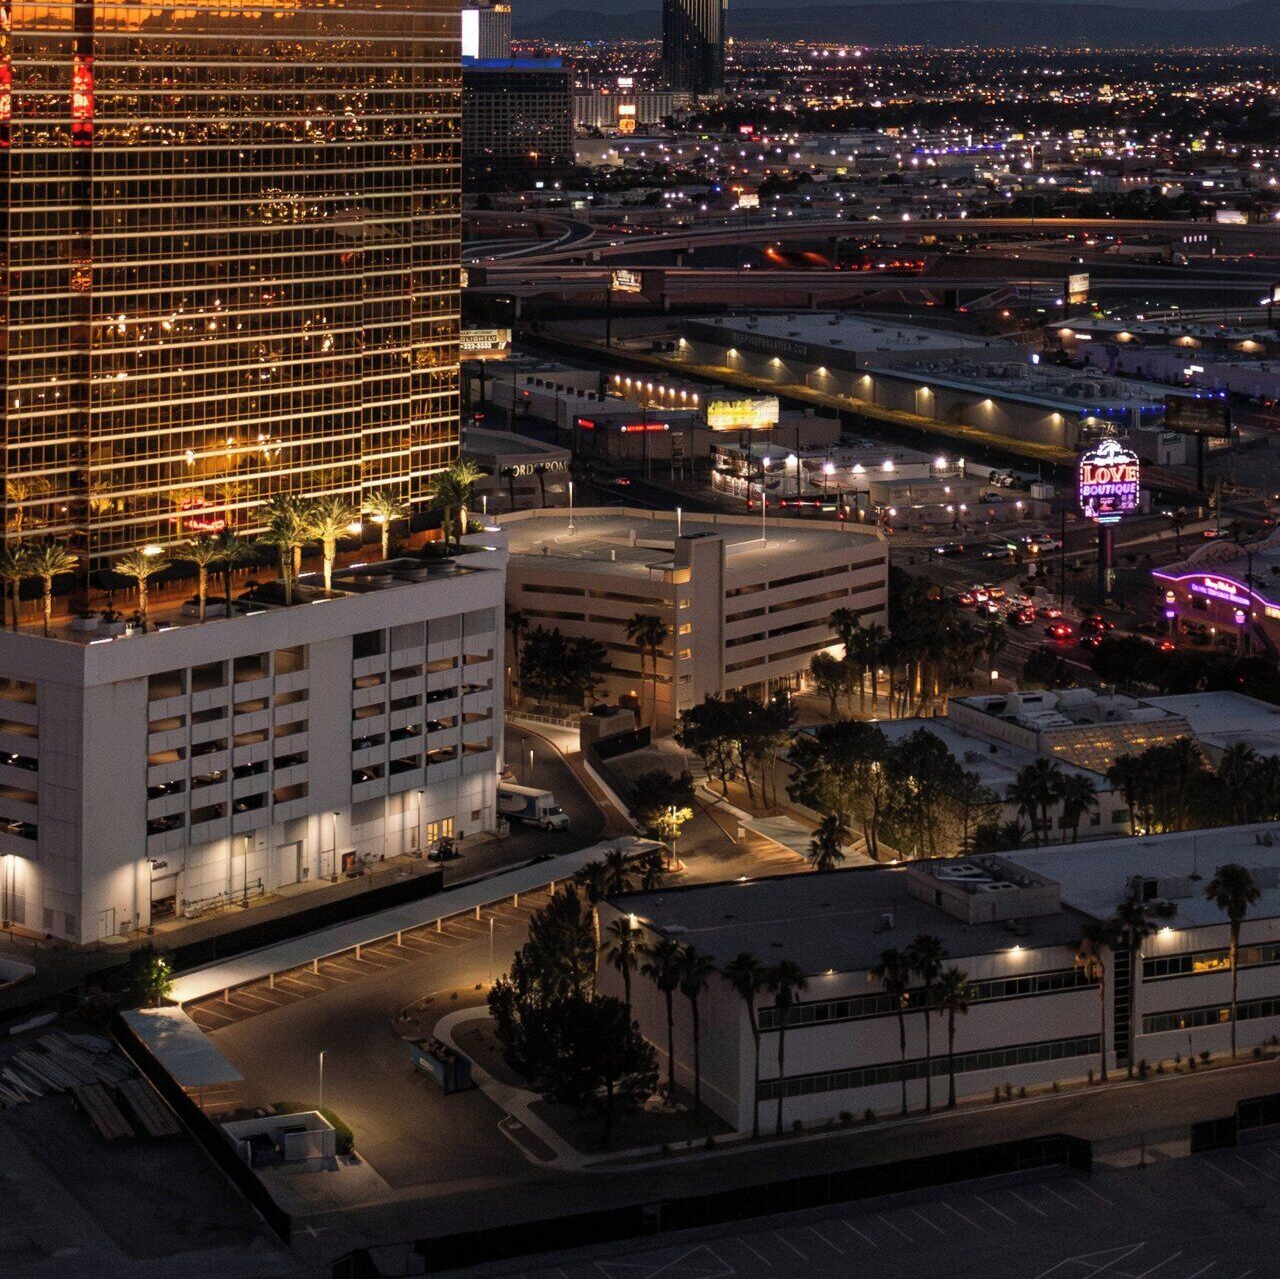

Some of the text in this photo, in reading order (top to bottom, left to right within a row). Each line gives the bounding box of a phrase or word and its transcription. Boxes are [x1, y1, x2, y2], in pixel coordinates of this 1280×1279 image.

[505, 461, 567, 477] ORDROM
[1083, 464, 1137, 485] LOVE
[1083, 483, 1136, 496] BOUTIQUE
